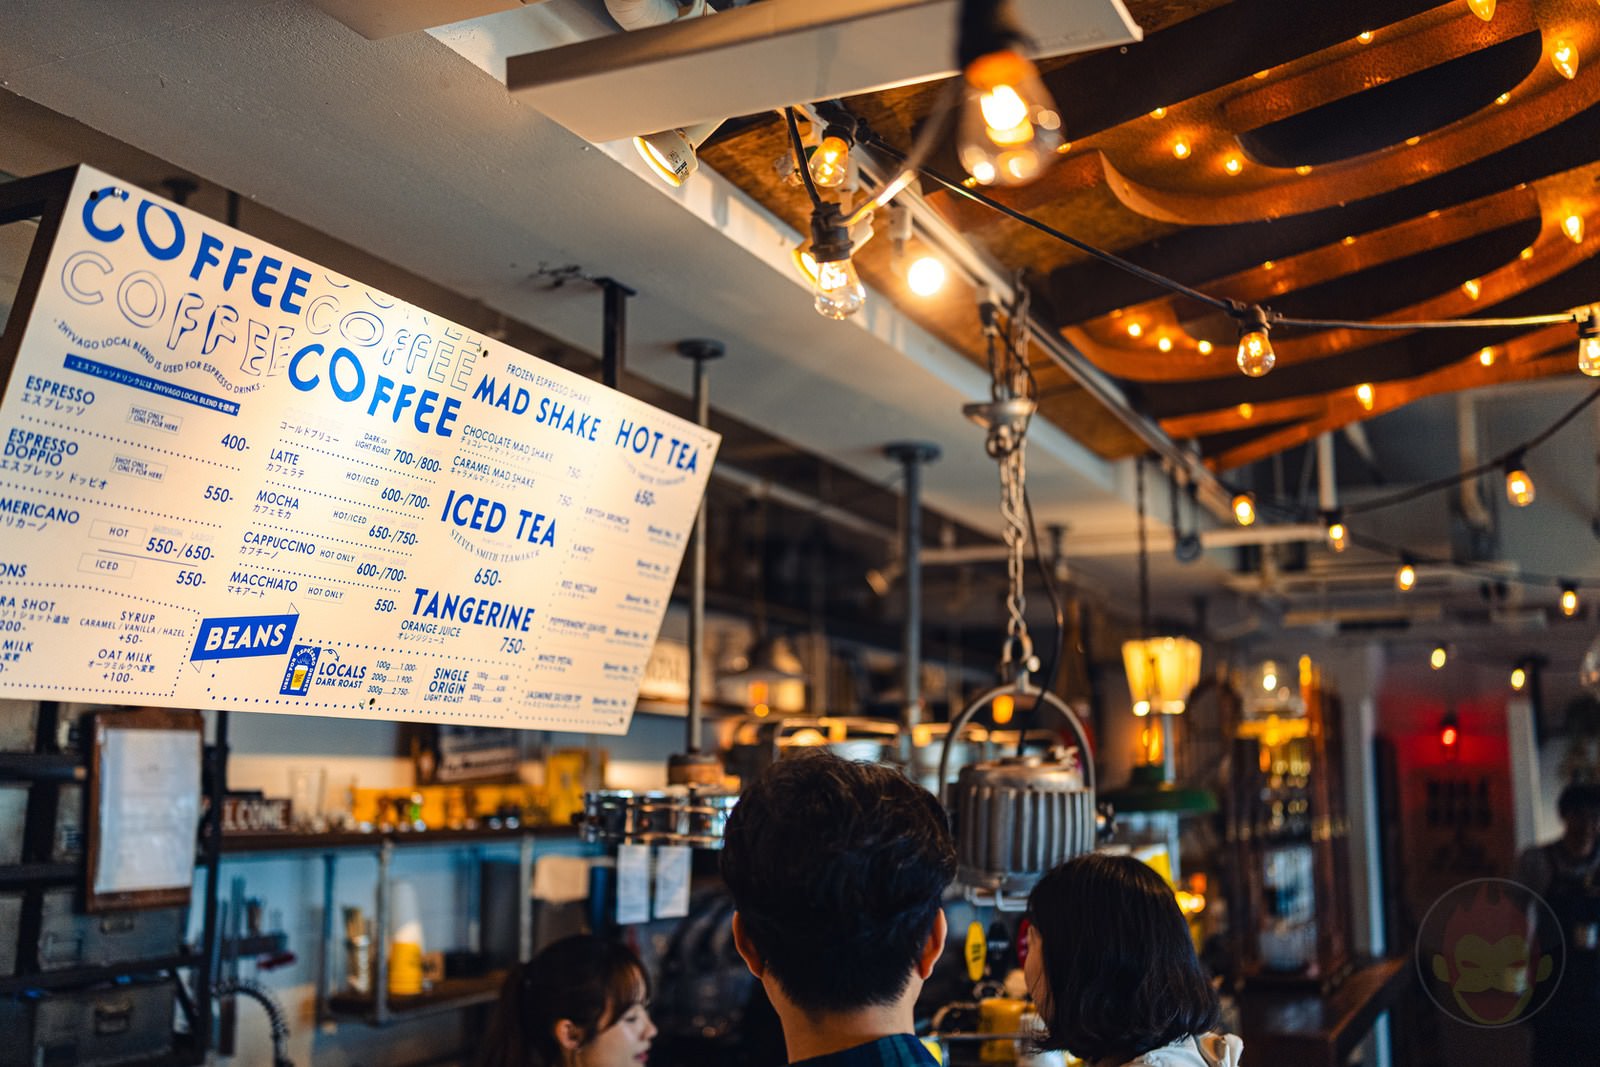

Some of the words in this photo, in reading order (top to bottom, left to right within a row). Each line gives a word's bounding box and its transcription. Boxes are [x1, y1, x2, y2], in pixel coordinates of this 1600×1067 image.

[82, 186, 312, 315] COFFEE
[61, 251, 295, 377] COFFEE
[306, 295, 477, 392] COFFEE
[58, 321, 99, 350] ZHYVAGO
[101, 336, 131, 348] LOCAL
[133, 341, 155, 365] BLEND
[154, 361, 162, 370] IS
[163, 363, 183, 373] USED
[186, 361, 202, 370] FOR
[203, 362, 233, 393] ESPRESSO
[233, 383, 260, 394] DRINKS
[506, 363, 536, 382] FROZEN
[26, 375, 95, 405] ESPRESSO
[181, 391, 199, 403] LOCAL
[288, 344, 462, 437] COFFEE
[131, 407, 147, 418] SHOT
[148, 412, 164, 421] ONLY
[472, 374, 530, 415] MAD
[536, 397, 601, 442] SHAKE
[133, 415, 150, 425] ONLY
[150, 419, 163, 428] FOR
[164, 422, 179, 431] HERE
[8, 428, 78, 455] ESPRESSO
[221, 433, 250, 451] 400-
[364, 433, 381, 444] DARK
[463, 425, 512, 448] CHOCOLATE
[512, 441, 530, 455] MAD
[531, 447, 554, 462] SHAKE
[615, 418, 664, 459] HOT
[666, 437, 698, 474] TEA
[4, 443, 62, 466] DOPPIO
[355, 440, 373, 453] LIGHT
[371, 445, 391, 456] ROAST
[115, 456, 130, 466] SHOT
[132, 461, 148, 470] ONLY
[270, 449, 300, 466] LATTE
[117, 464, 134, 473] ONLY
[135, 467, 147, 477] FOR
[149, 470, 163, 480] HERE
[265, 463, 305, 479] カフェラテ
[345, 472, 380, 487] HOT/ICED
[453, 456, 491, 475] CARAMEL
[492, 468, 511, 480] MAD
[511, 473, 535, 488] SHAKE
[203, 485, 234, 503] 550-
[256, 490, 300, 510] MOCHA
[252, 503, 292, 520] カフェモカ
[333, 510, 368, 525] HOT/ICED
[440, 490, 507, 533] ICED
[516, 509, 556, 548] TEA
[109, 527, 129, 538] HOT
[146, 537, 215, 561] 550-/650-
[243, 531, 316, 555] CAPPUCCINO
[450, 529, 474, 553] STEVEN
[476, 547, 498, 562] SMITH
[95, 559, 119, 571] ICED
[319, 550, 335, 560] HOT
[336, 552, 356, 563] ONLY
[176, 570, 207, 587] 550-
[229, 571, 298, 592] MACCHIATO
[474, 567, 502, 586] 650-
[226, 585, 266, 599] マキアート
[308, 587, 323, 597] HOT
[324, 589, 345, 599] ONLY
[21, 598, 57, 613] SHOT
[374, 599, 397, 613] 550-
[412, 588, 535, 632] TANGERINE
[120, 611, 156, 624] SYRUP
[79, 618, 116, 631] CARAMEL
[124, 624, 156, 634] VANILLA
[163, 628, 185, 637] HAZEL
[401, 620, 438, 635] ORANGE
[438, 626, 462, 638] JUICE
[119, 634, 143, 645] +50-
[204, 623, 287, 651] BEANS
[500, 637, 526, 654] 750-
[2, 639, 34, 653] MILK
[98, 649, 123, 660] OAT
[126, 651, 152, 663] MILK
[319, 662, 367, 679] LOCALS
[376, 660, 391, 671] 100g
[103, 670, 134, 683] +100-
[316, 677, 337, 687] DARK
[338, 679, 363, 689] ROAST
[371, 672, 387, 682] 200g
[434, 667, 470, 682] SINGLE
[367, 685, 383, 695] 300g
[429, 681, 466, 694] ORIGIN
[443, 695, 464, 703] ROAST
